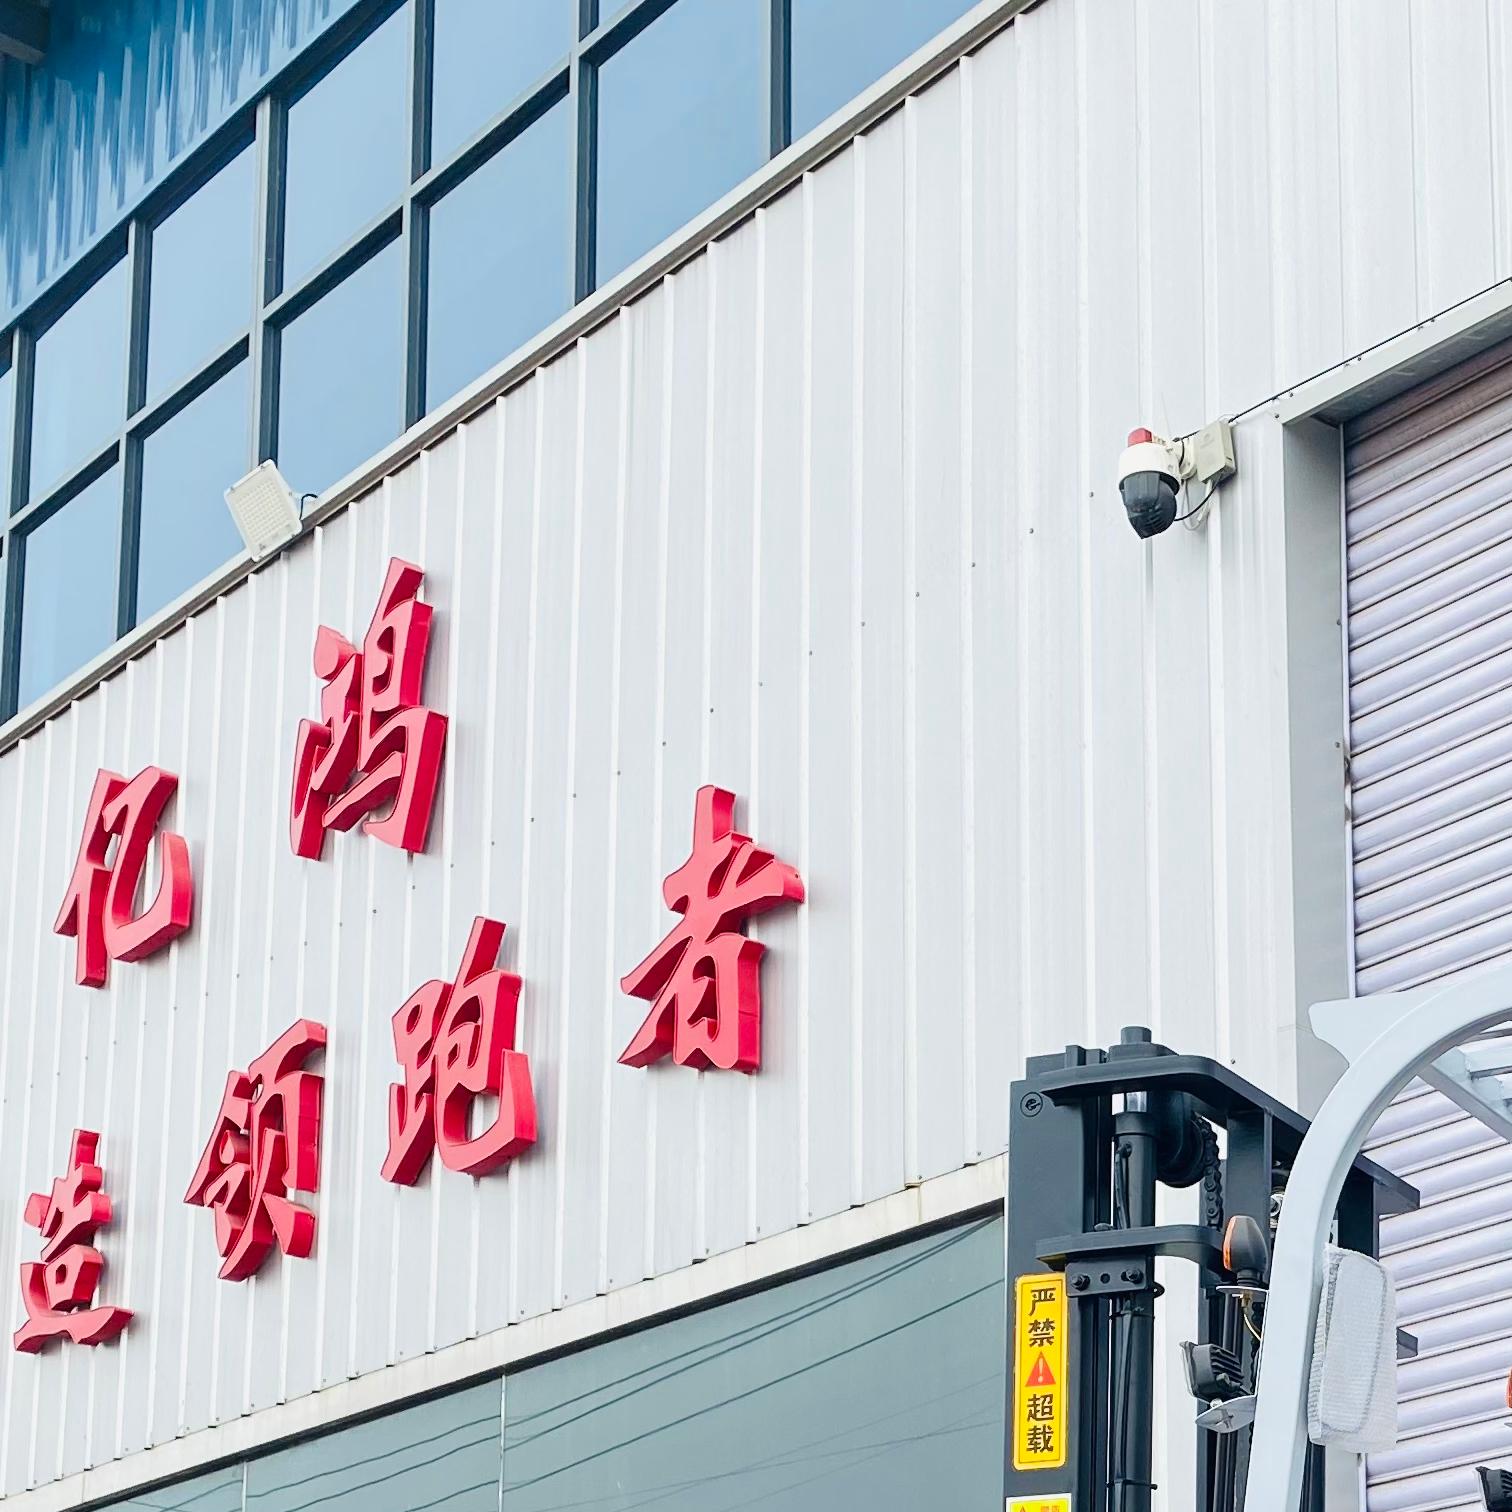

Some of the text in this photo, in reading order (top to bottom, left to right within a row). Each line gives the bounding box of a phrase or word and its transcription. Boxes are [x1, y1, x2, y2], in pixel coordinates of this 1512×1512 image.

[55, 557, 448, 987] 亿鸿
[15, 785, 806, 1352] 造领跑者
